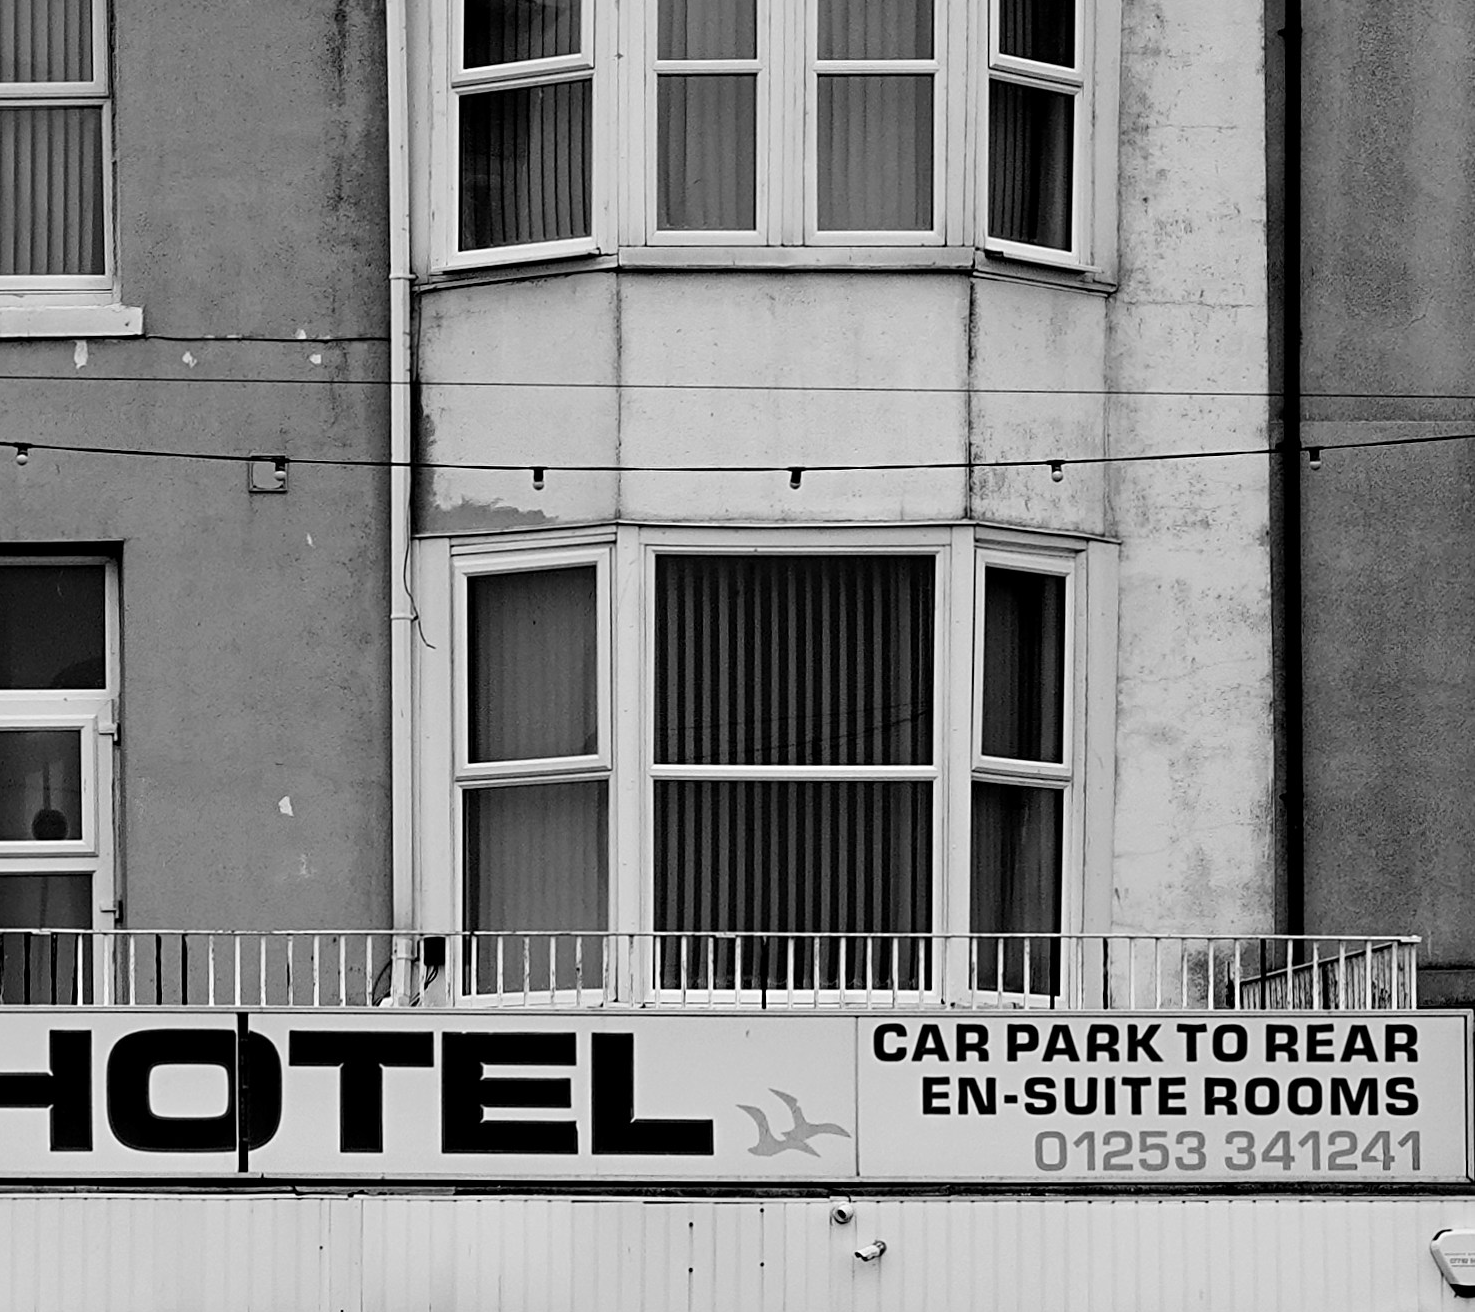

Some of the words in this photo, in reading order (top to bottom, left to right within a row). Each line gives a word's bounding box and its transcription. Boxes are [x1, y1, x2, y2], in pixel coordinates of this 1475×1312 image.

[874, 1024, 989, 1061] CAR
[1007, 1024, 1163, 1062] PARK
[1177, 1024, 1247, 1062] TO
[1266, 1024, 1418, 1062] REAR
[923, 1077, 1186, 1115] EN-SUITE
[1205, 1077, 1418, 1115] ROOMS
[1035, 1131, 1206, 1171] 01253
[1225, 1131, 1420, 1171] 341241
